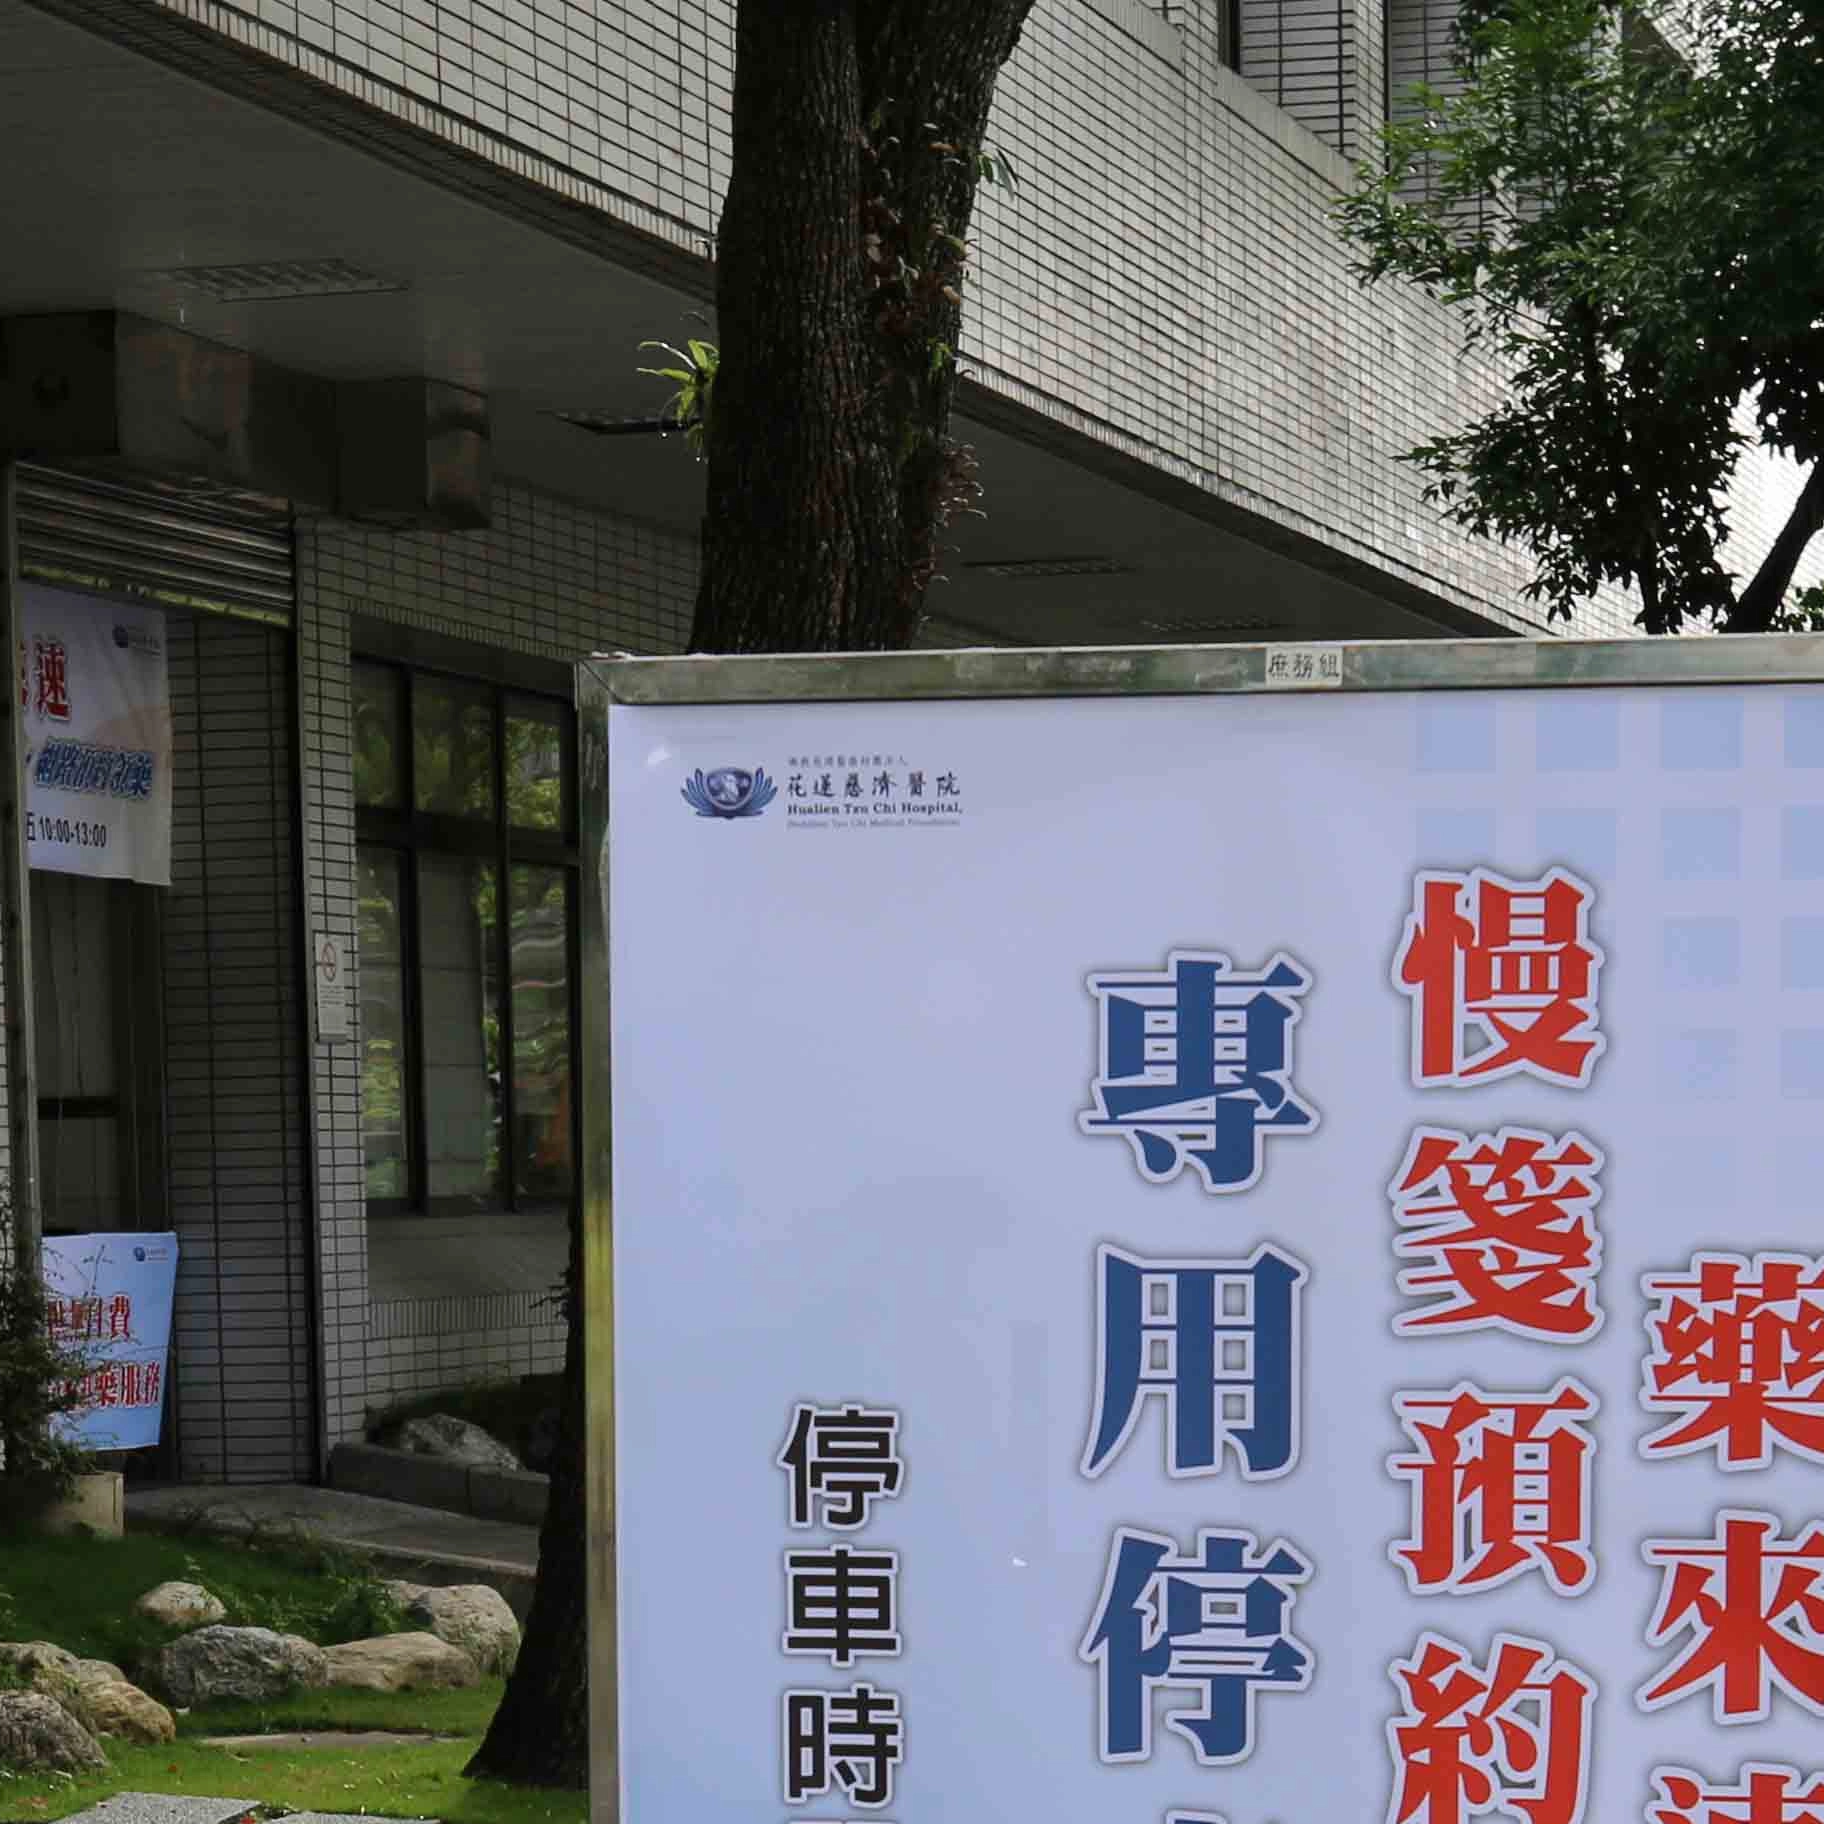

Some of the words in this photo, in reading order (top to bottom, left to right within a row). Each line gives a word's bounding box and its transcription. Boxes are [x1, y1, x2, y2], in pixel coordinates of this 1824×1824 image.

[1268, 654, 1339, 680] 庶務組
[788, 770, 961, 798] 花蓮慈濟醫院
[787, 803, 839, 815] Hualien
[873, 801, 897, 815] Chi
